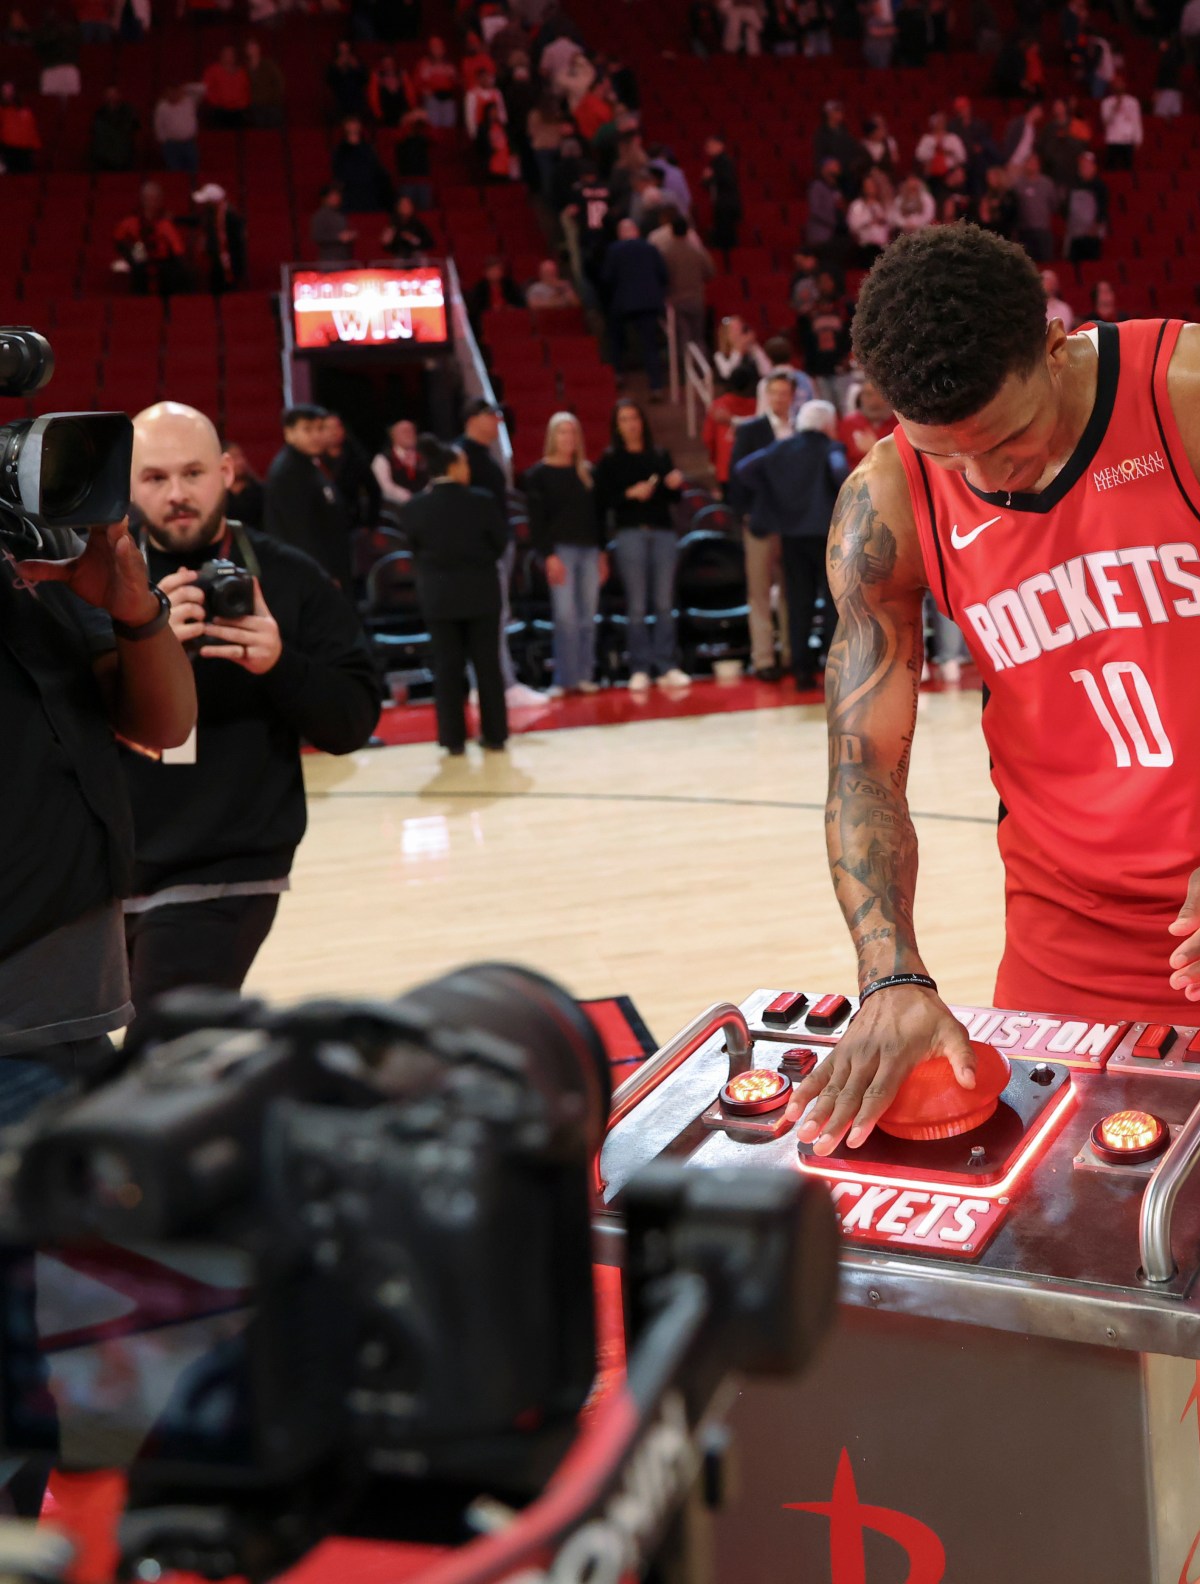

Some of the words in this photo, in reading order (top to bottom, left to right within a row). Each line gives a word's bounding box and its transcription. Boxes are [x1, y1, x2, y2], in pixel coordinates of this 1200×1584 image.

[1093, 451, 1163, 481] MEMORIAL
[1094, 460, 1165, 492] HERMANN
[1069, 661, 1174, 768] 10
[953, 1011, 1119, 1056] USTON
